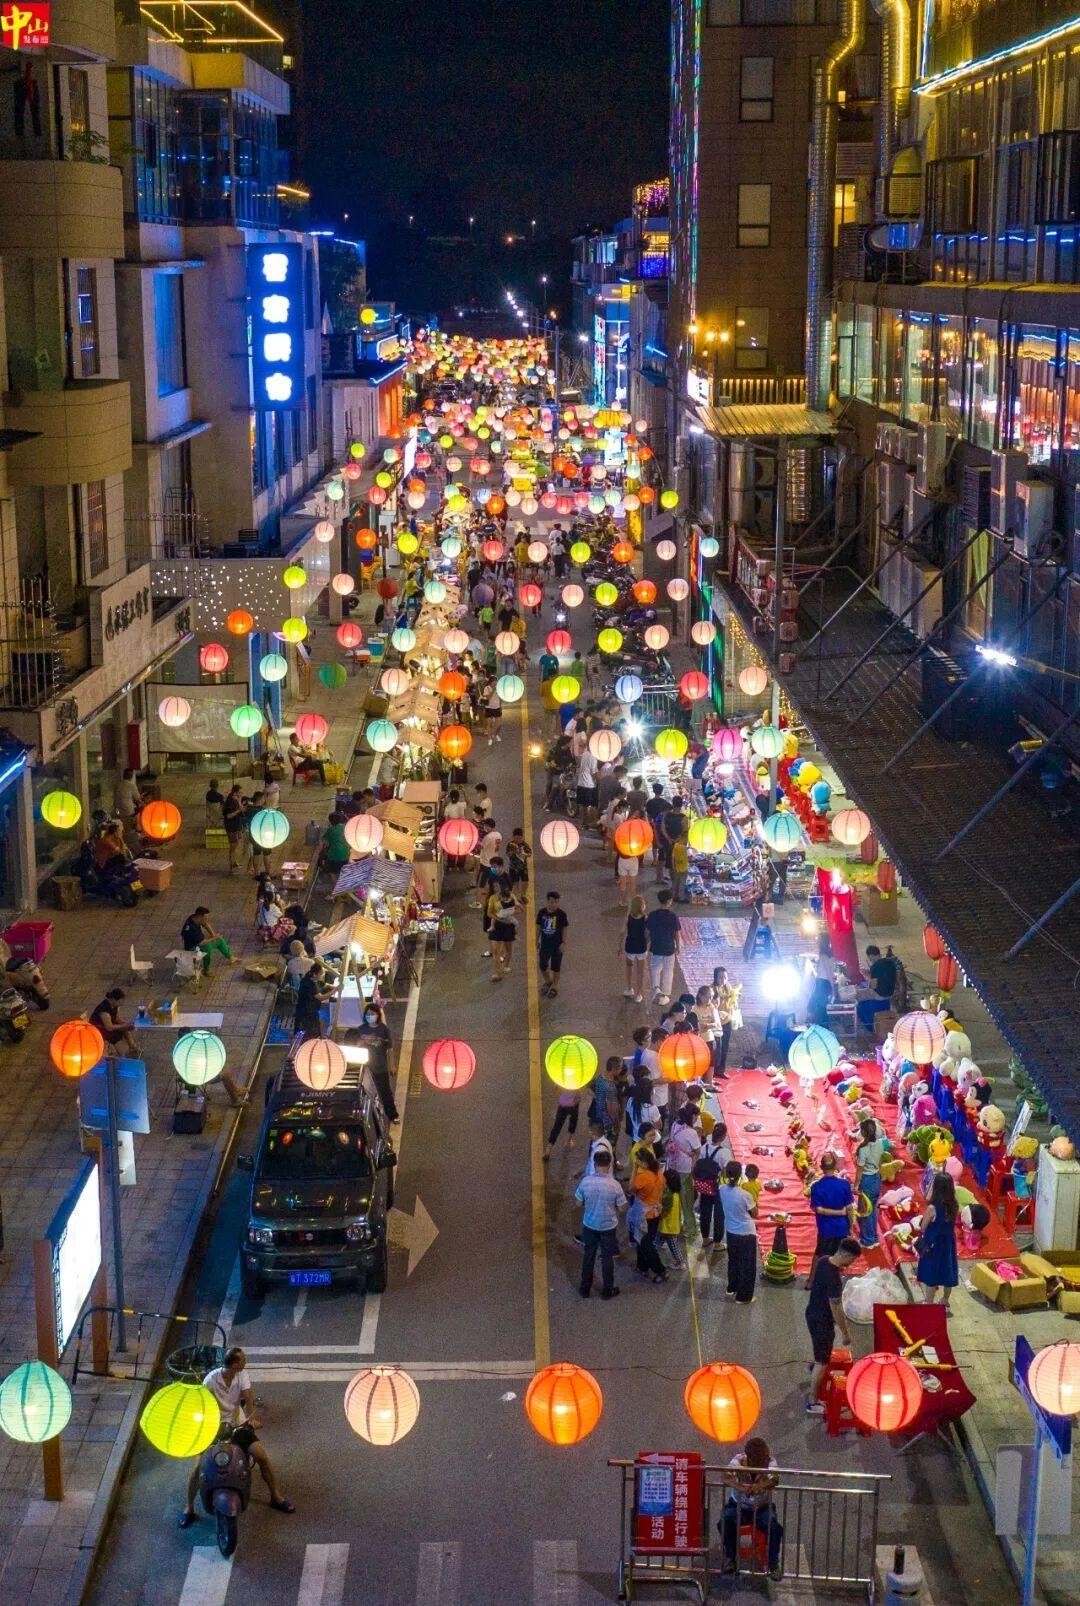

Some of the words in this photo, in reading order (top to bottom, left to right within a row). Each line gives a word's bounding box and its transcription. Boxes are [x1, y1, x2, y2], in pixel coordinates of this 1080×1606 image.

[652, 1516, 664, 1540] 活动
[675, 1458, 688, 1547] 请车辆绕道行驶
